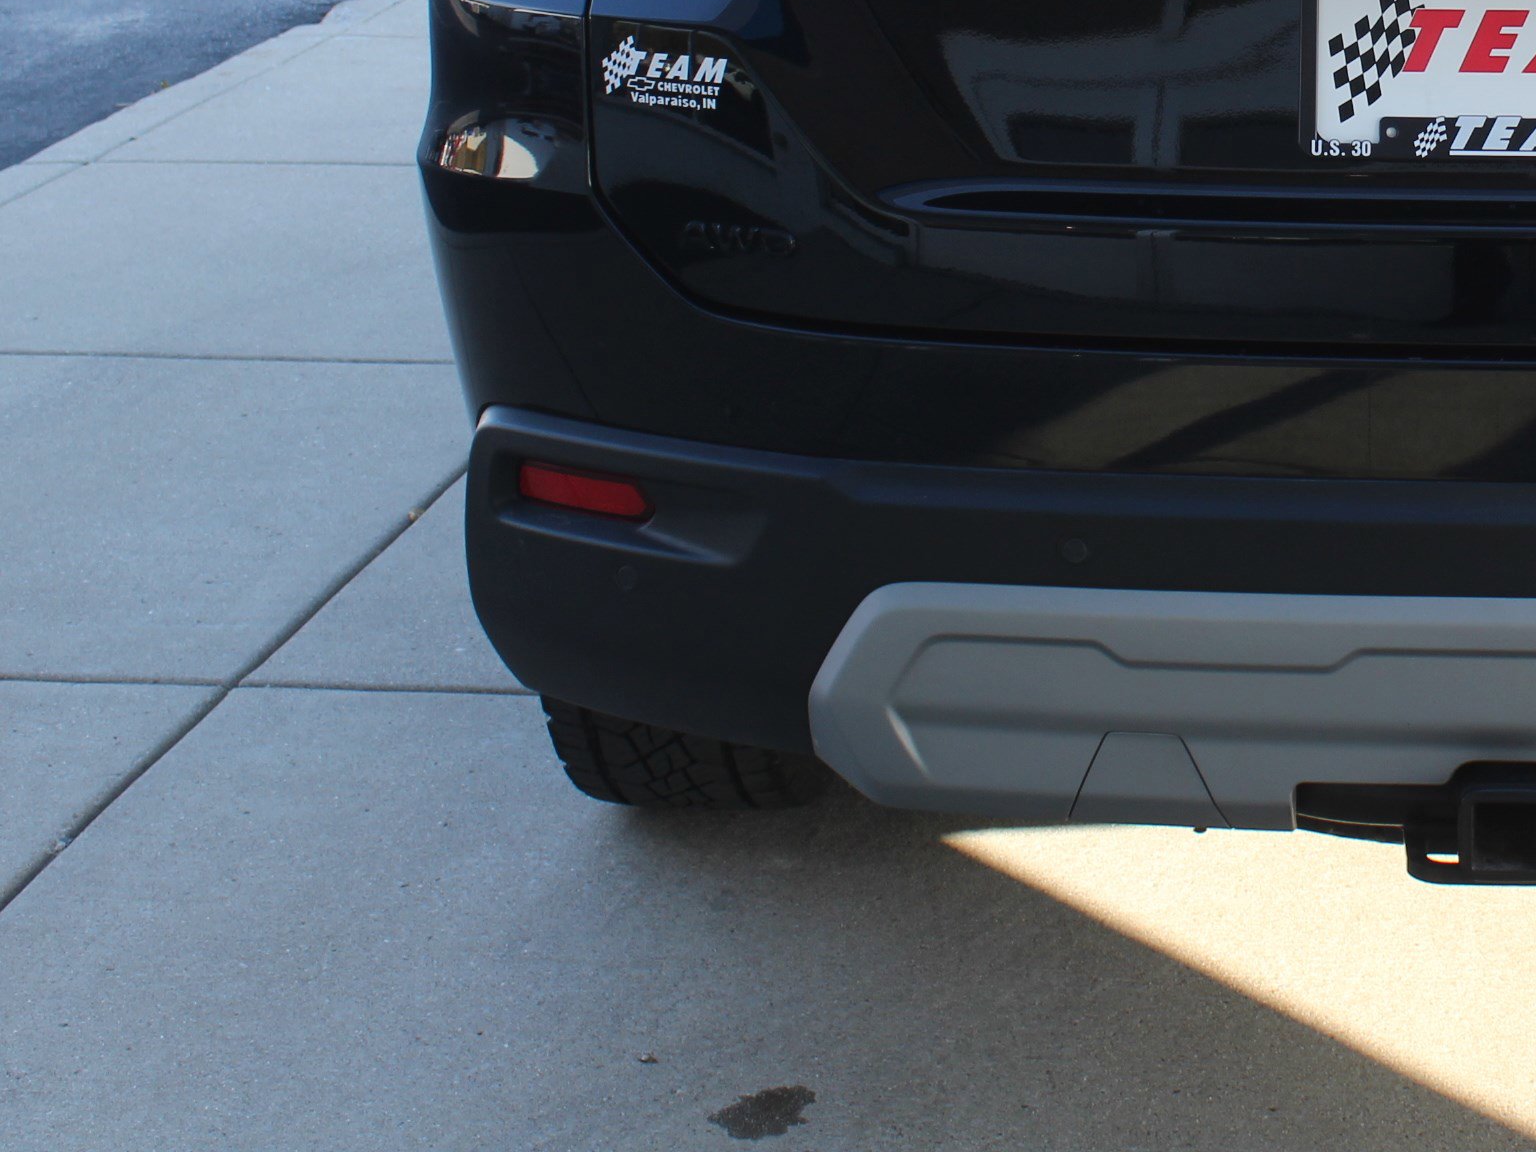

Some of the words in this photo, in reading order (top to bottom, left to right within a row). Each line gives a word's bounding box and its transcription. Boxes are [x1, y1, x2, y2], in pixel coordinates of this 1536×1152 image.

[625, 50, 728, 84] TEAM
[657, 81, 720, 97] CHEVROLET
[630, 91, 701, 111] Valparaiso,
[702, 98, 717, 110] IN
[1310, 139, 1346, 157] U.S.
[1350, 139, 1372, 157] 30
